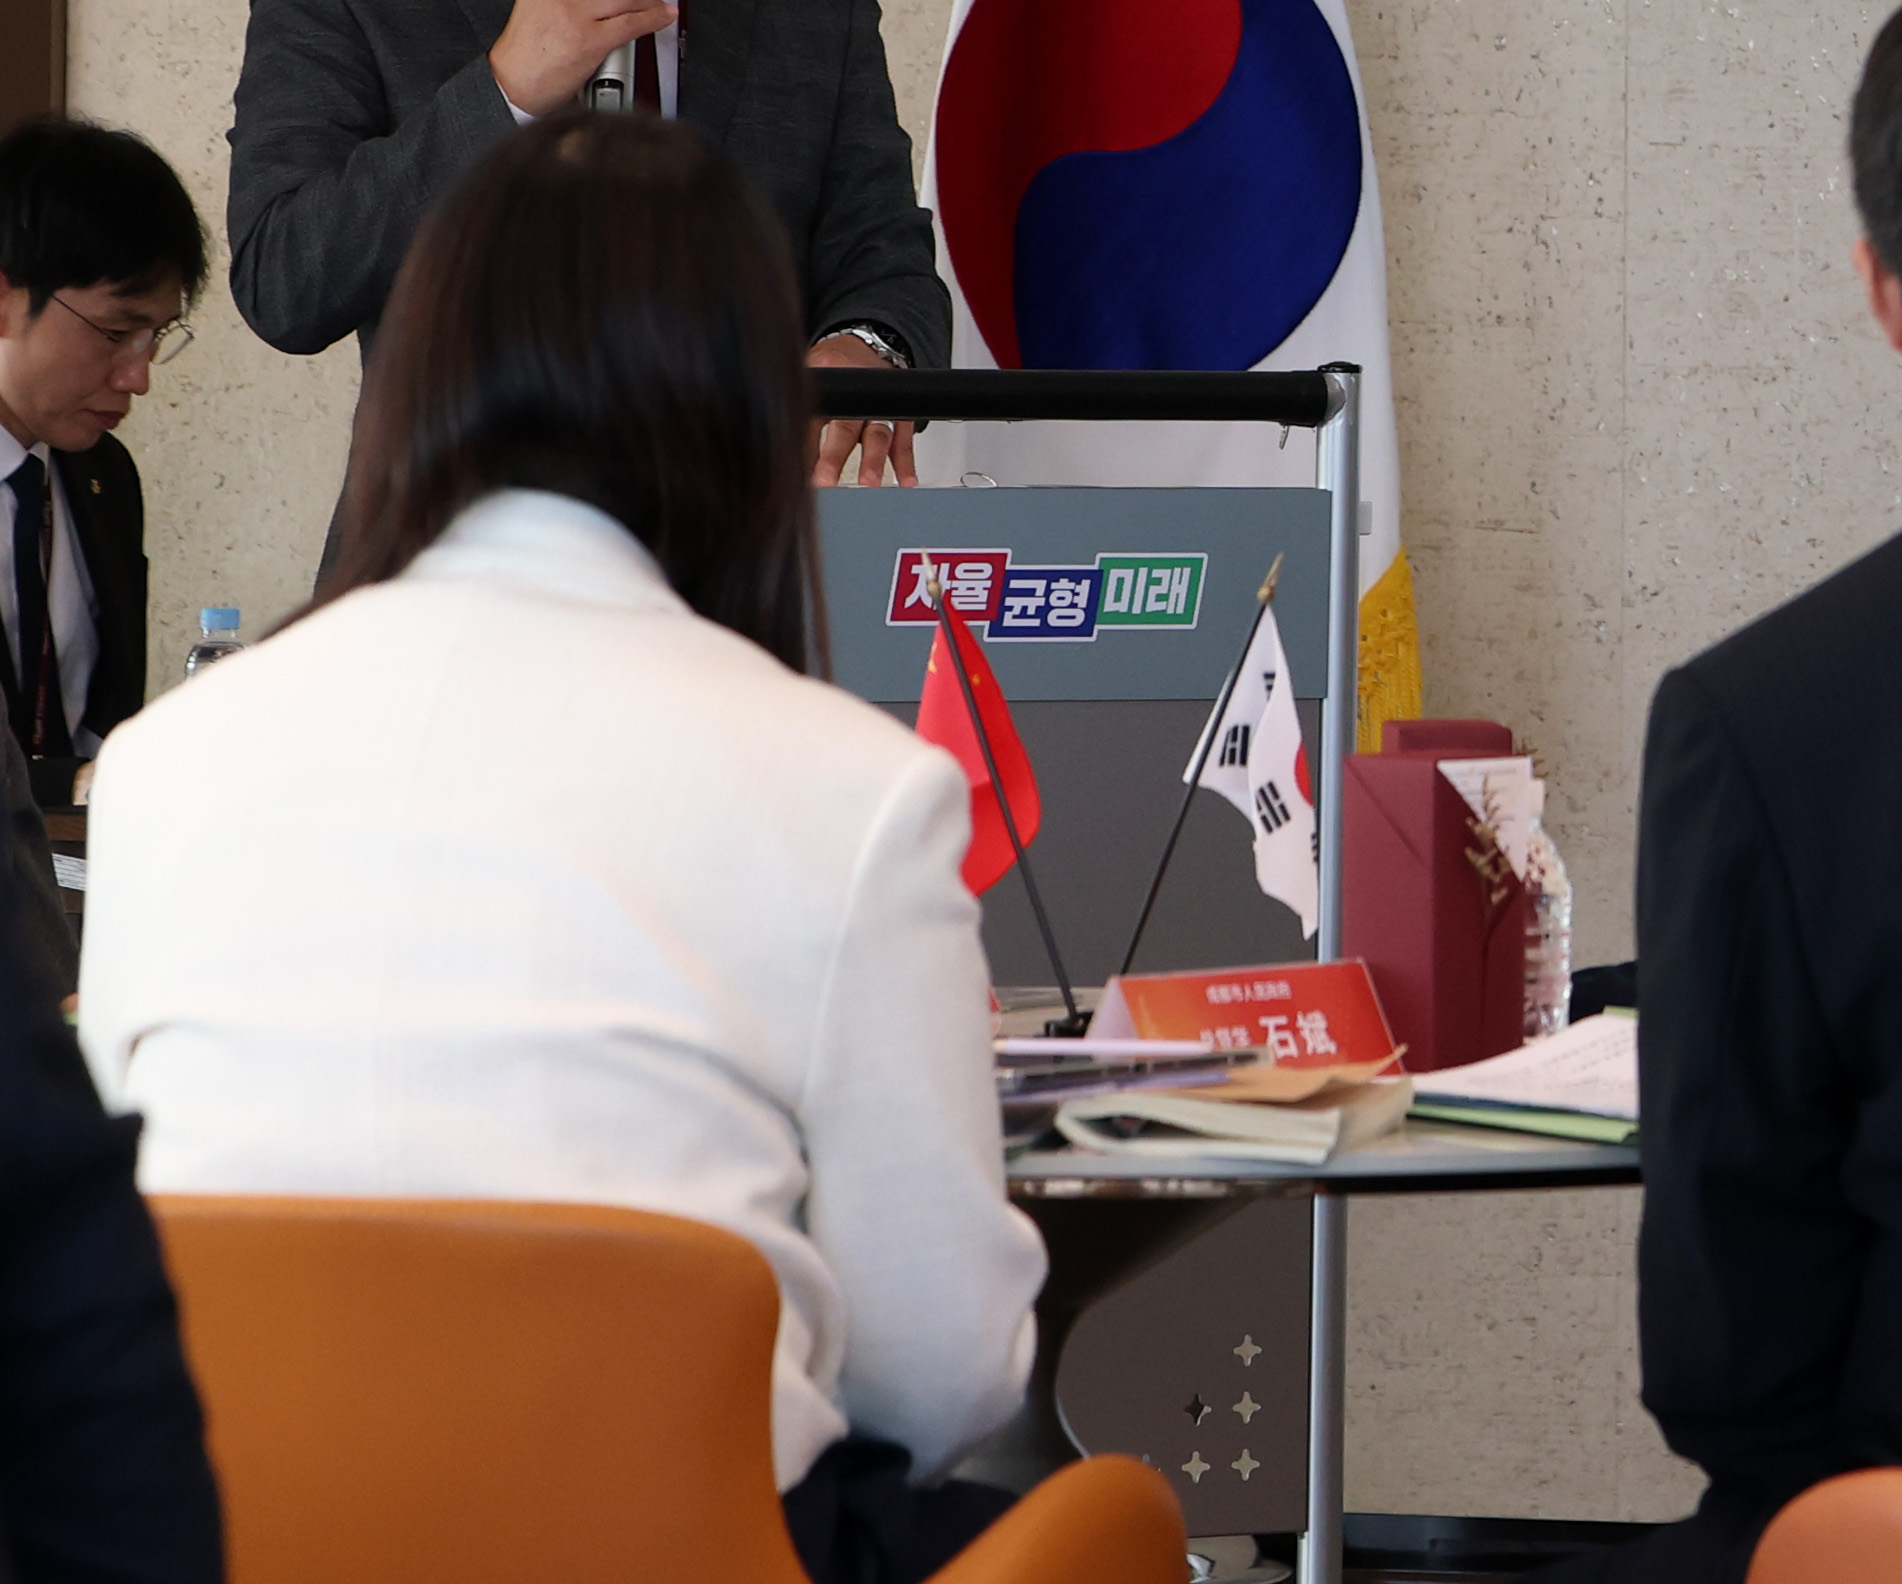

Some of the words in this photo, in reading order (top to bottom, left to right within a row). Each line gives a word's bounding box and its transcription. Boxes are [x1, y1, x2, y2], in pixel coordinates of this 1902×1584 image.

[903, 561, 994, 612] 자율
[1001, 577, 1092, 628] 균형
[1102, 566, 1193, 615] 미래
